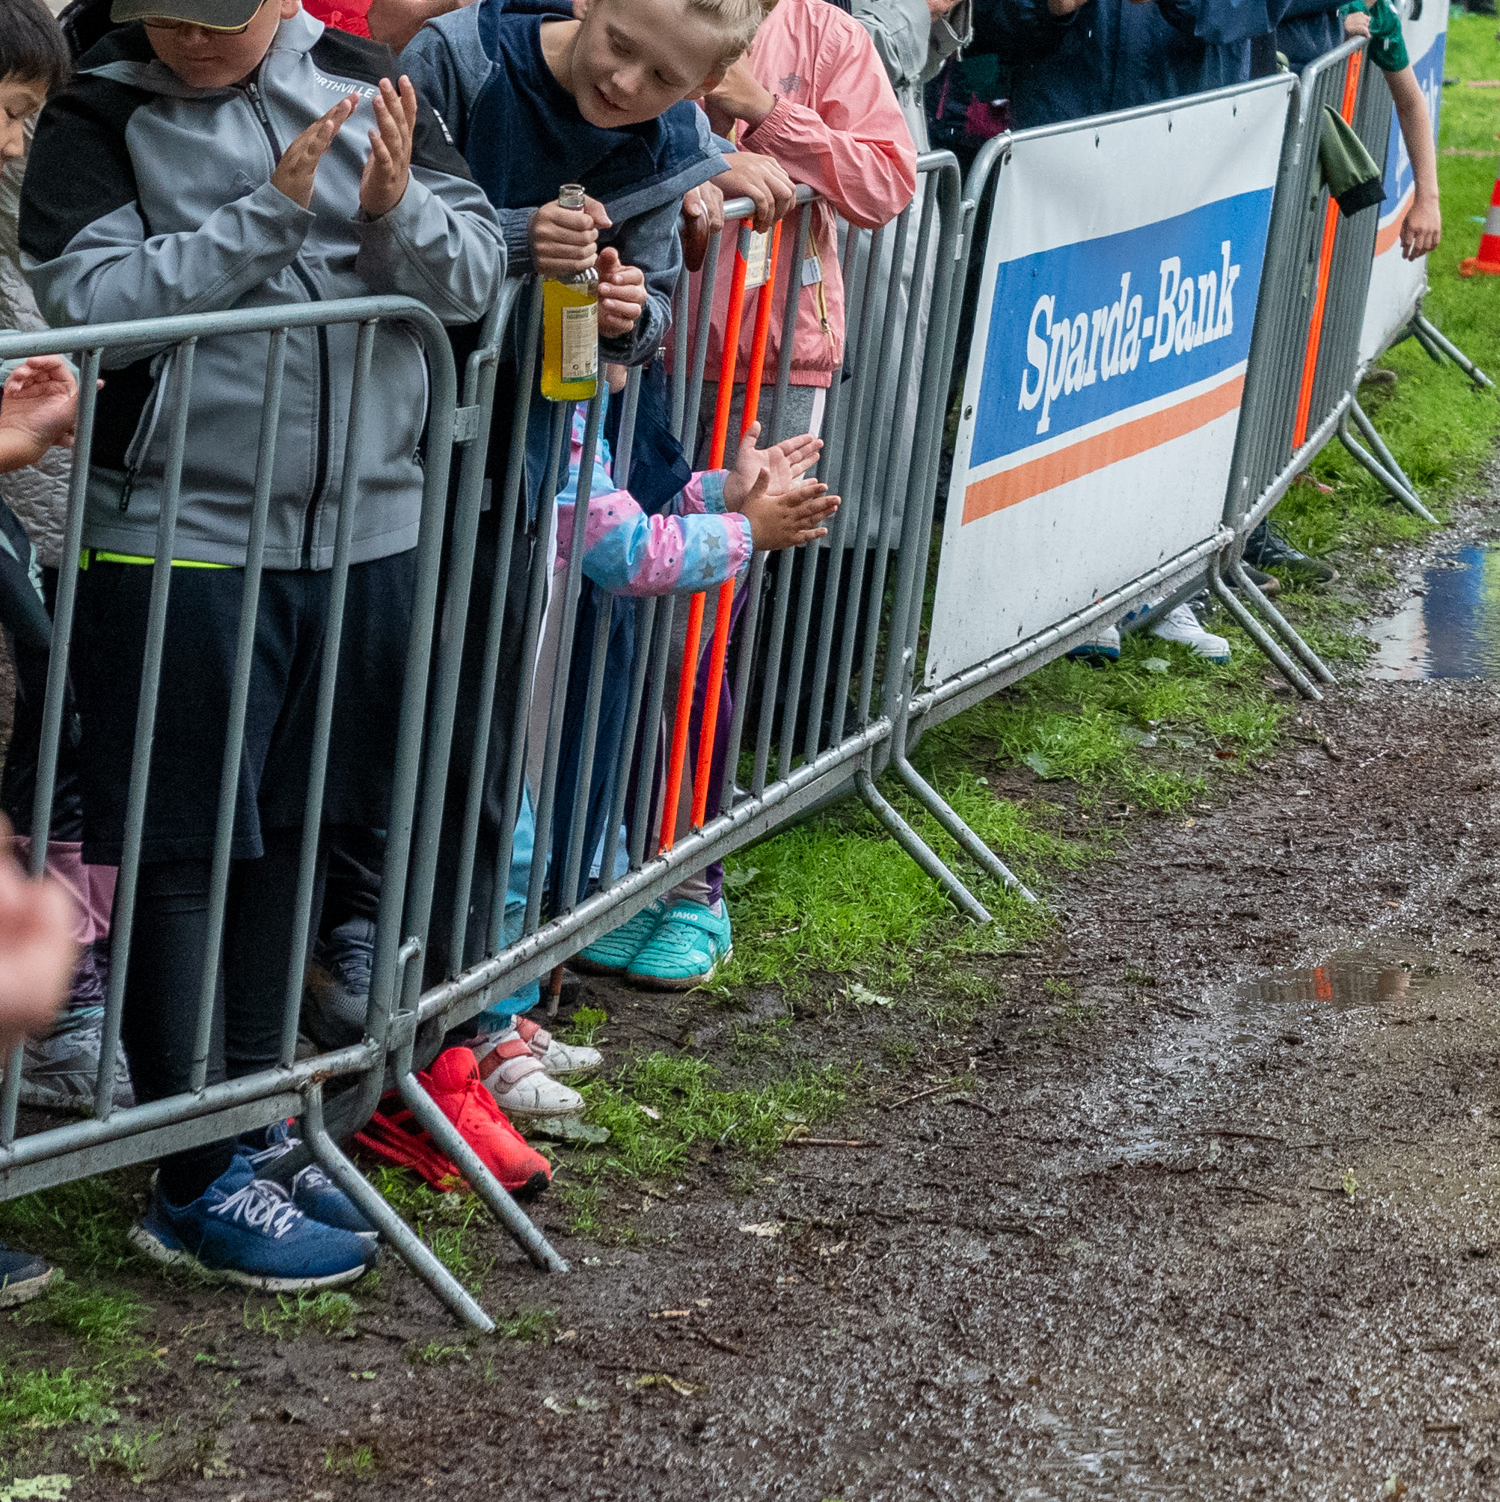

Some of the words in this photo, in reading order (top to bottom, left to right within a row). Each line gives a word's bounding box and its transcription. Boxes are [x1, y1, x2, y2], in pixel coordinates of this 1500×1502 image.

[312, 69, 376, 99] ORTHVILLE
[1018, 239, 1241, 435] Sparda-Bank
[671, 911, 699, 922] JAKO
